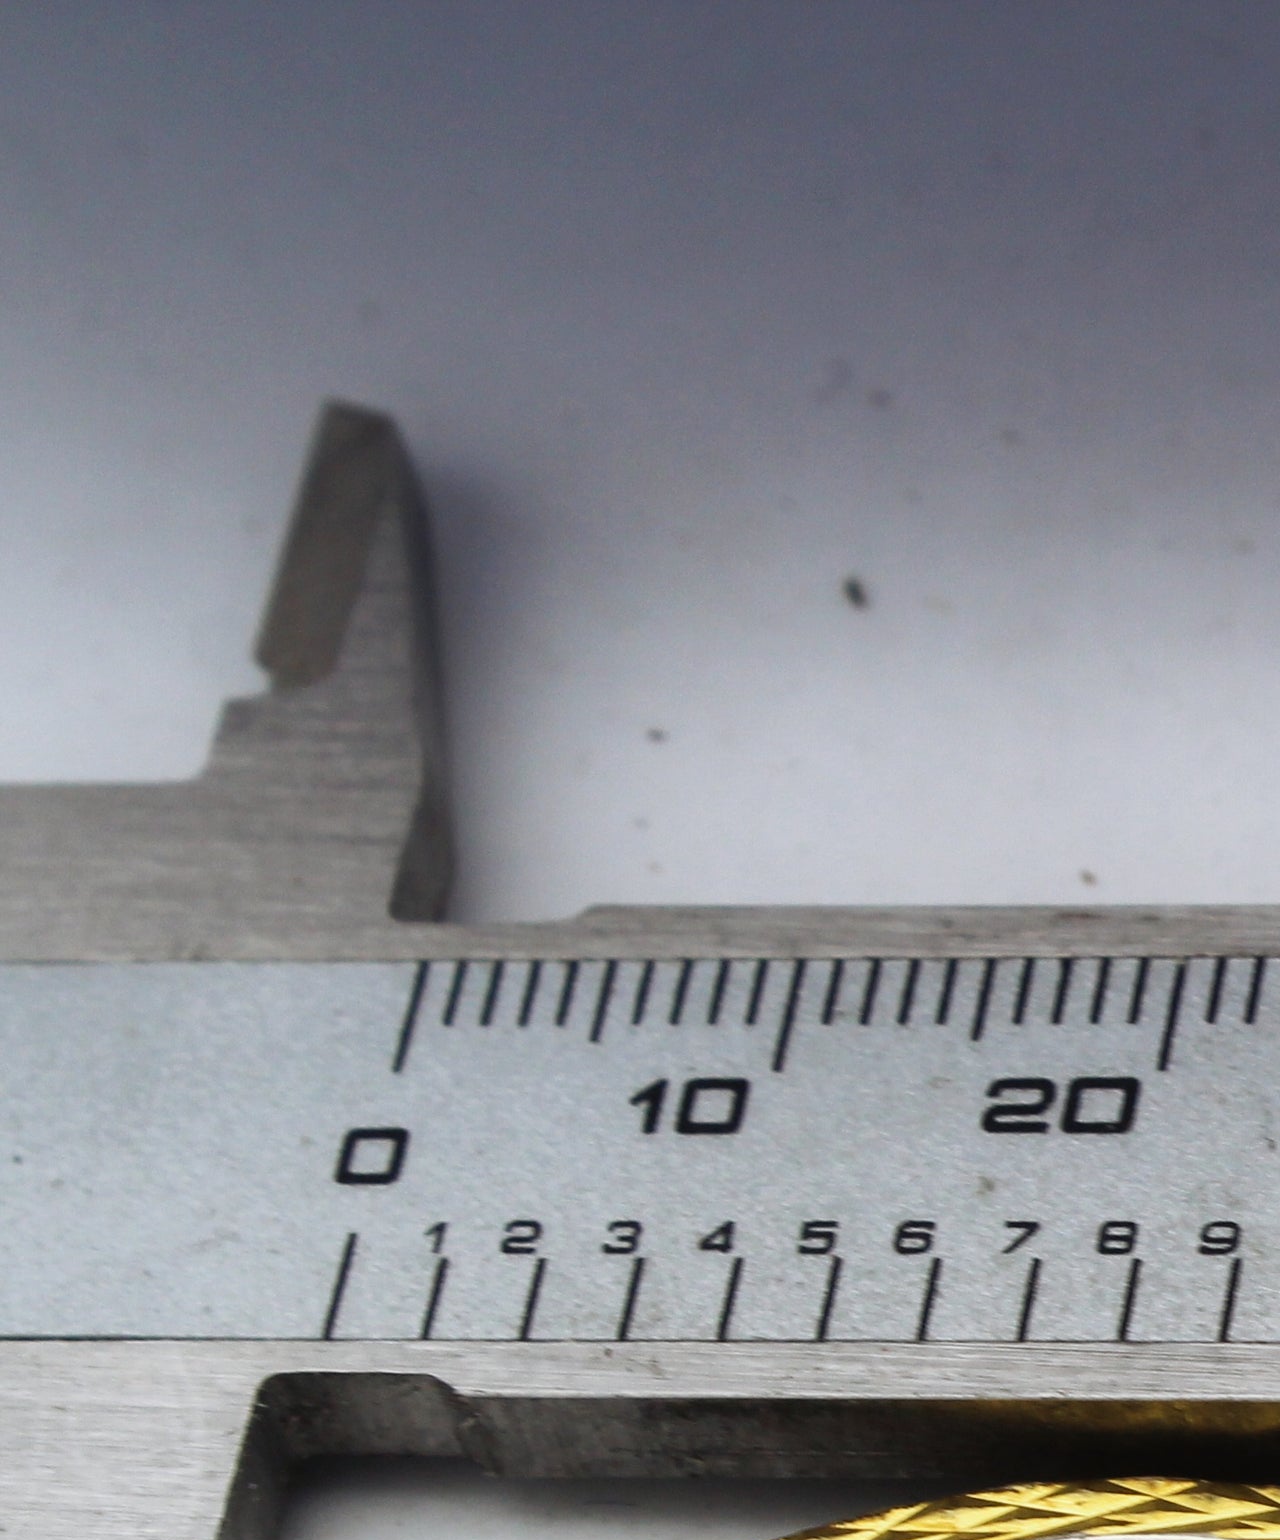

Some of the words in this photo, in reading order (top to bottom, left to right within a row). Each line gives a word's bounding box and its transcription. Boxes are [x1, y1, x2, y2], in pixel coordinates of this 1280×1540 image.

[333, 1126, 412, 1187] 0
[628, 1076, 753, 1137] 10
[979, 1075, 1144, 1137] 20
[425, 1221, 448, 1255] 1
[499, 1218, 544, 1256] 2
[600, 1219, 644, 1256] 3
[697, 1219, 736, 1255] 4
[796, 1219, 840, 1257] 5
[891, 1218, 937, 1257] 6
[1001, 1219, 1042, 1256] 7
[1095, 1219, 1140, 1257] 8
[1196, 1219, 1244, 1257] 9
